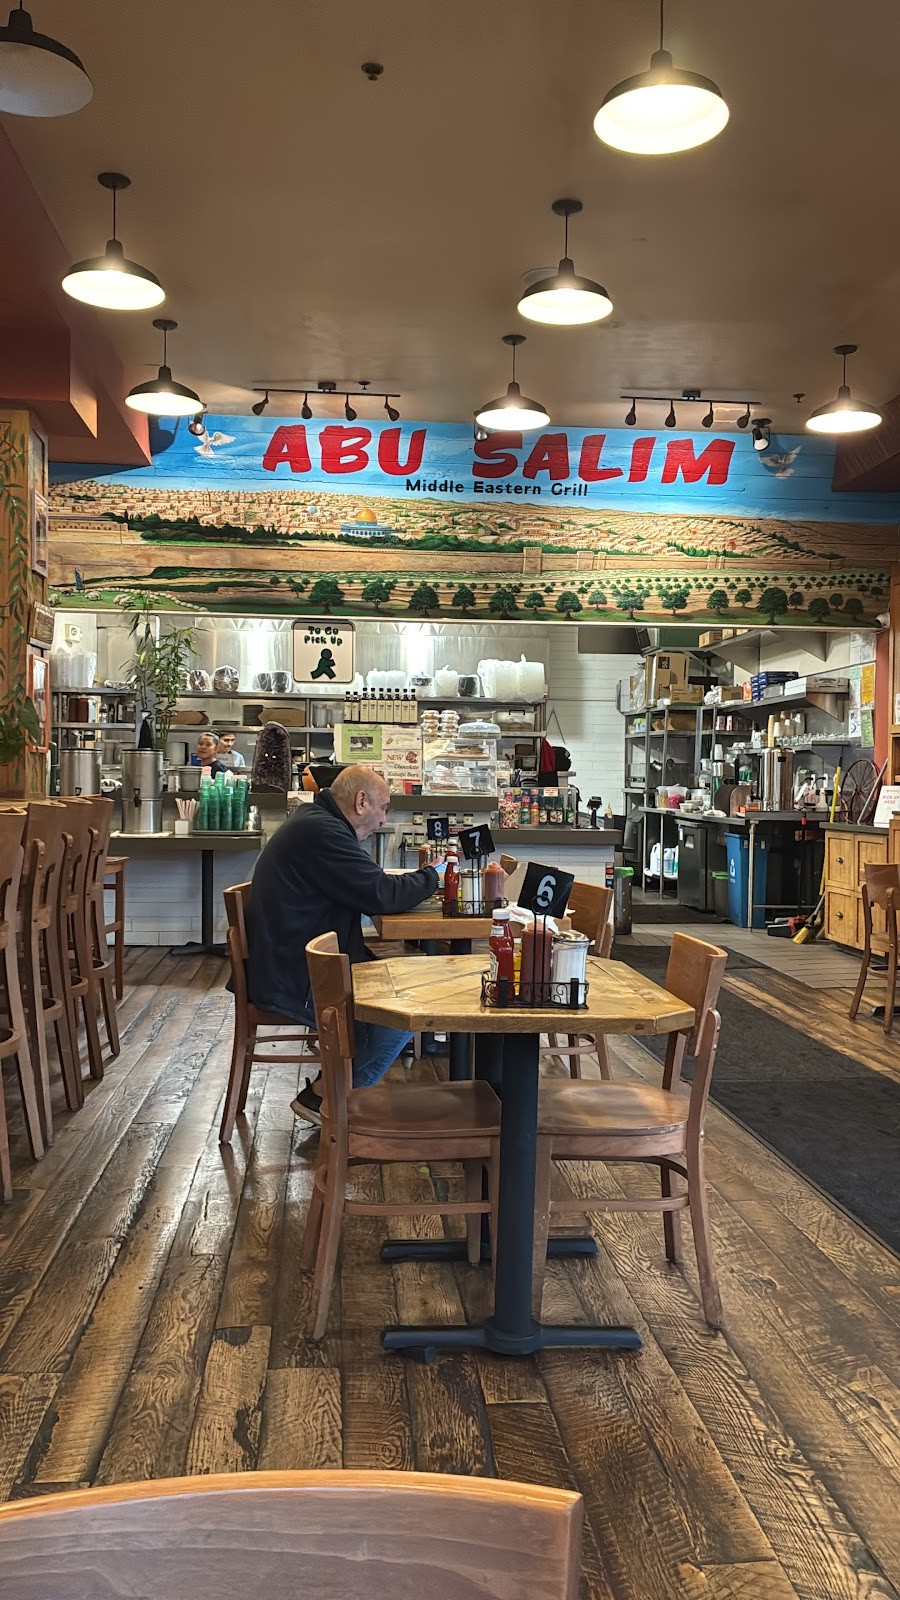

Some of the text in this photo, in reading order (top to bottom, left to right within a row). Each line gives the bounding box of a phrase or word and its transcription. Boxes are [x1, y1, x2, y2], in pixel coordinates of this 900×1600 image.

[262, 424, 737, 486] ABU SALIM
[405, 479, 588, 496] Middle Eastern Grill
[308, 626, 339, 635] To Go
[304, 635, 343, 647] Pick Up
[434, 821, 442, 836] 8
[469, 831, 480, 852] 7
[536, 875, 556, 907] 6
